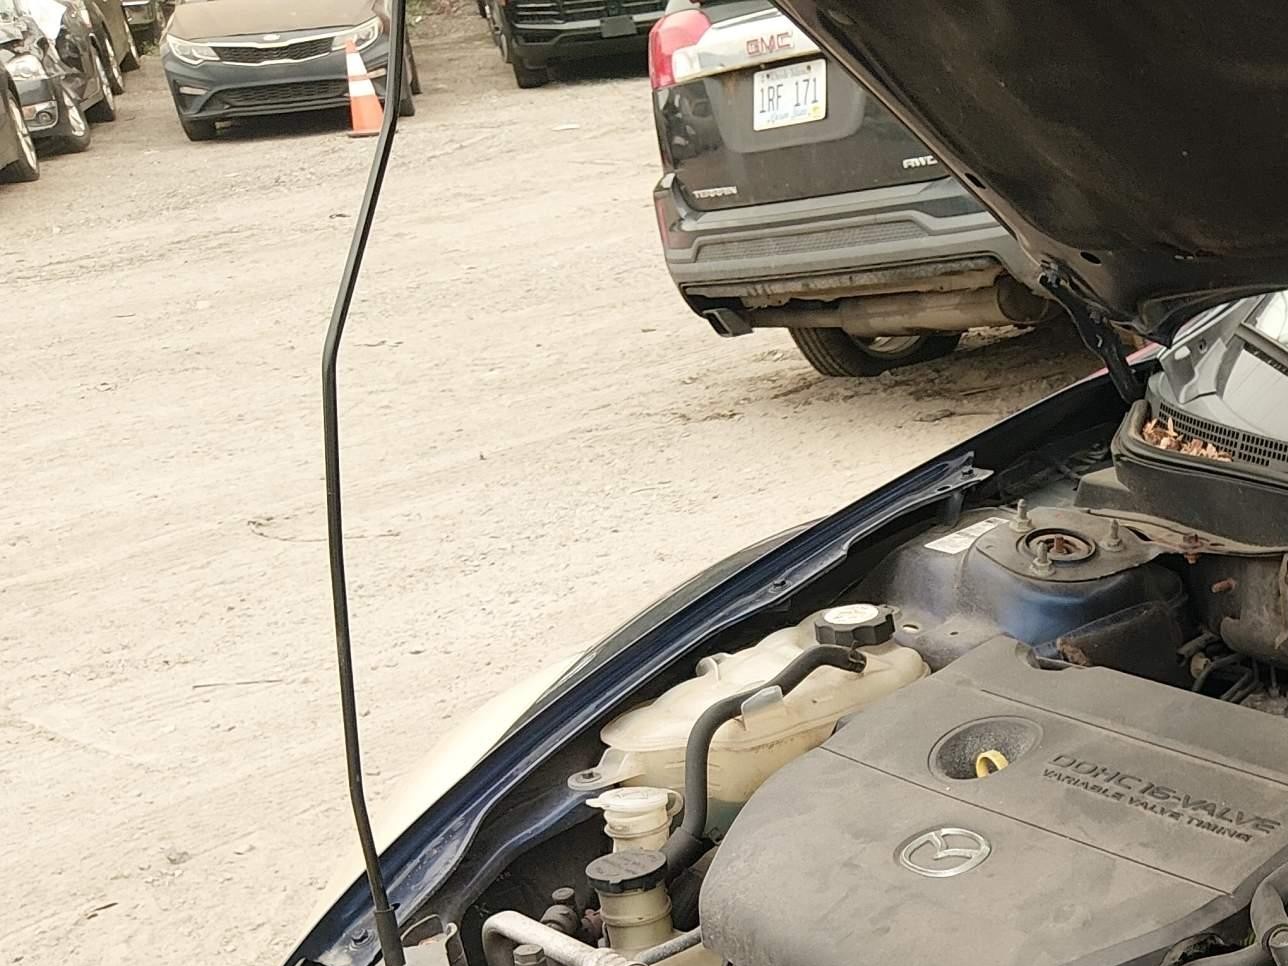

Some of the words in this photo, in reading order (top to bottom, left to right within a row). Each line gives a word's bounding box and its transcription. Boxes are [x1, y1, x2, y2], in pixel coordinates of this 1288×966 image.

[746, 31, 793, 56] GMC
[760, 83, 784, 113] 1RF
[794, 77, 818, 107] 171
[1042, 768, 1124, 801] VARIABLE
[1127, 796, 1183, 821] VALVE
[1186, 815, 1254, 843] TIMING
[1048, 754, 1142, 790] DOHC
[1138, 781, 1281, 834] 16-VALVE
